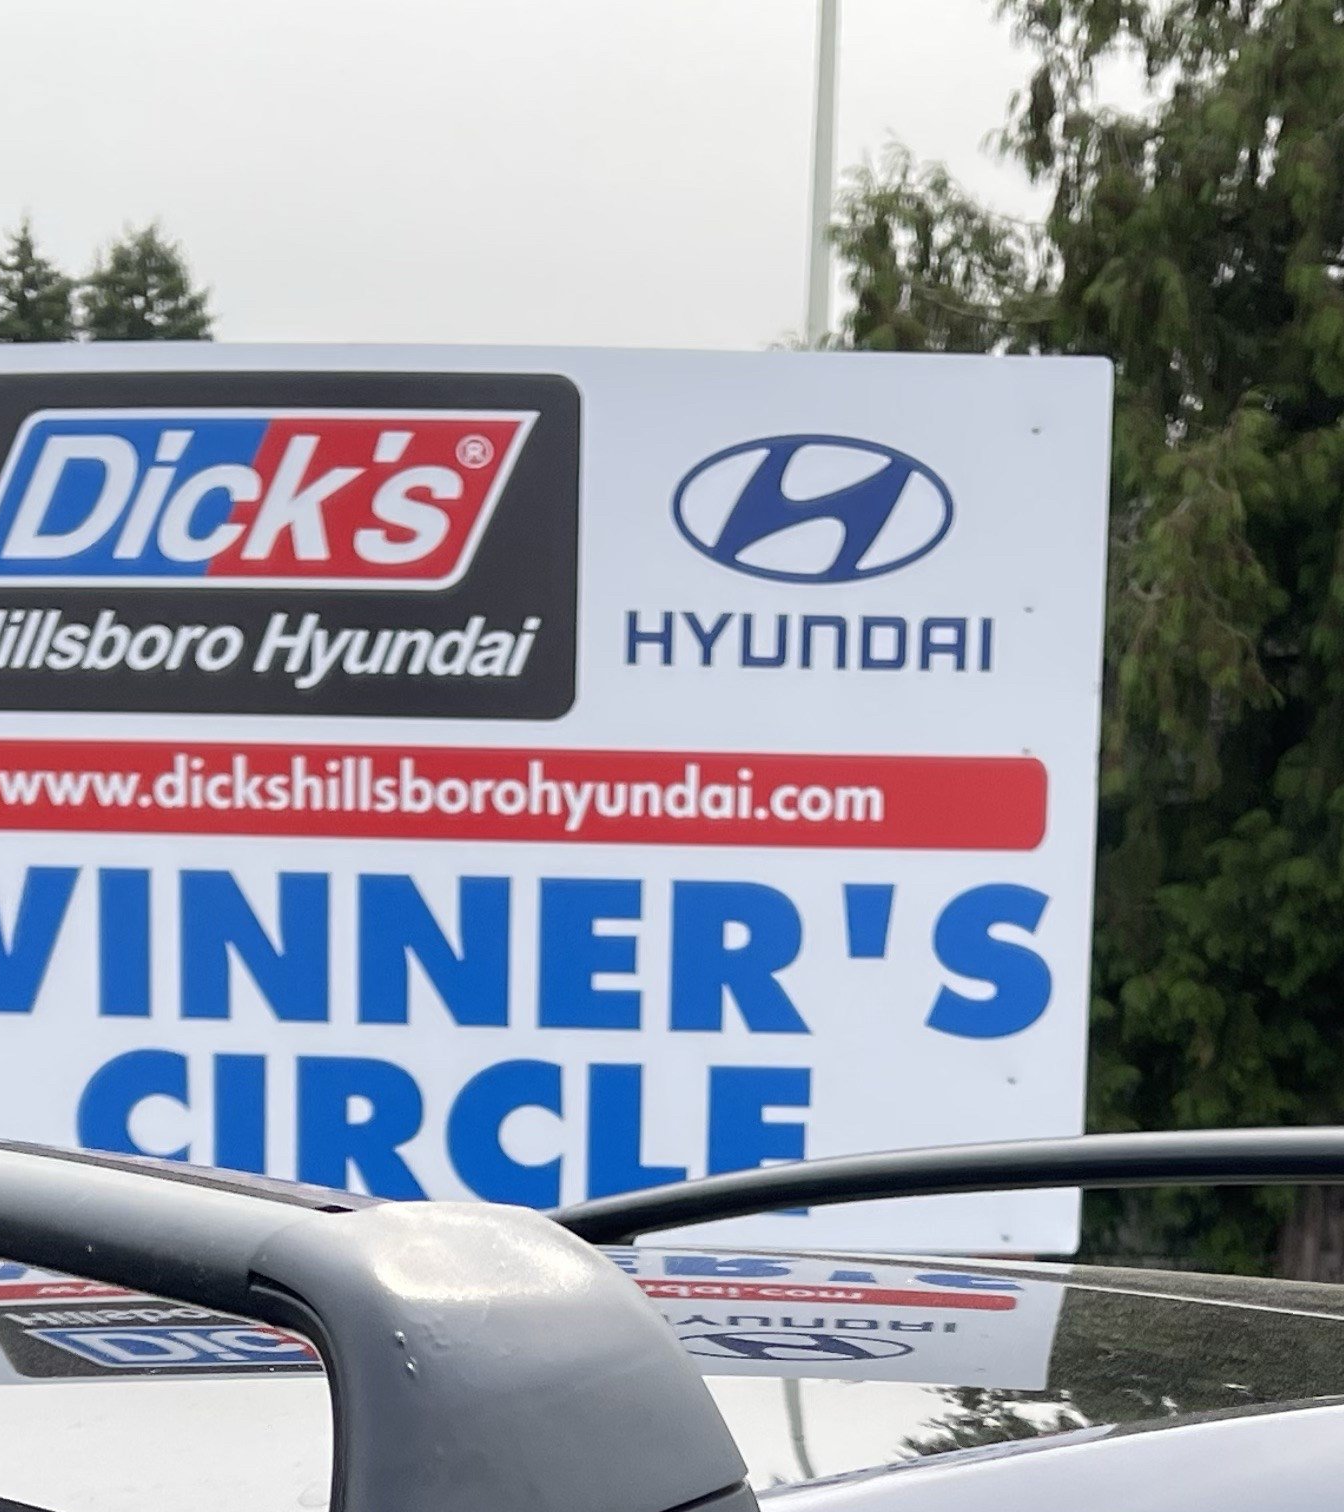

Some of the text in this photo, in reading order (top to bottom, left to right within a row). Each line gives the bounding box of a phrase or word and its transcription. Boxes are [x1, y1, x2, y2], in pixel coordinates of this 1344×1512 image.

[0, 429, 464, 566] Dick's
[253, 612, 542, 689] Hyundai
[626, 609, 993, 673] HYUNDAI
[74, 1046, 813, 1215] CIRCLE
